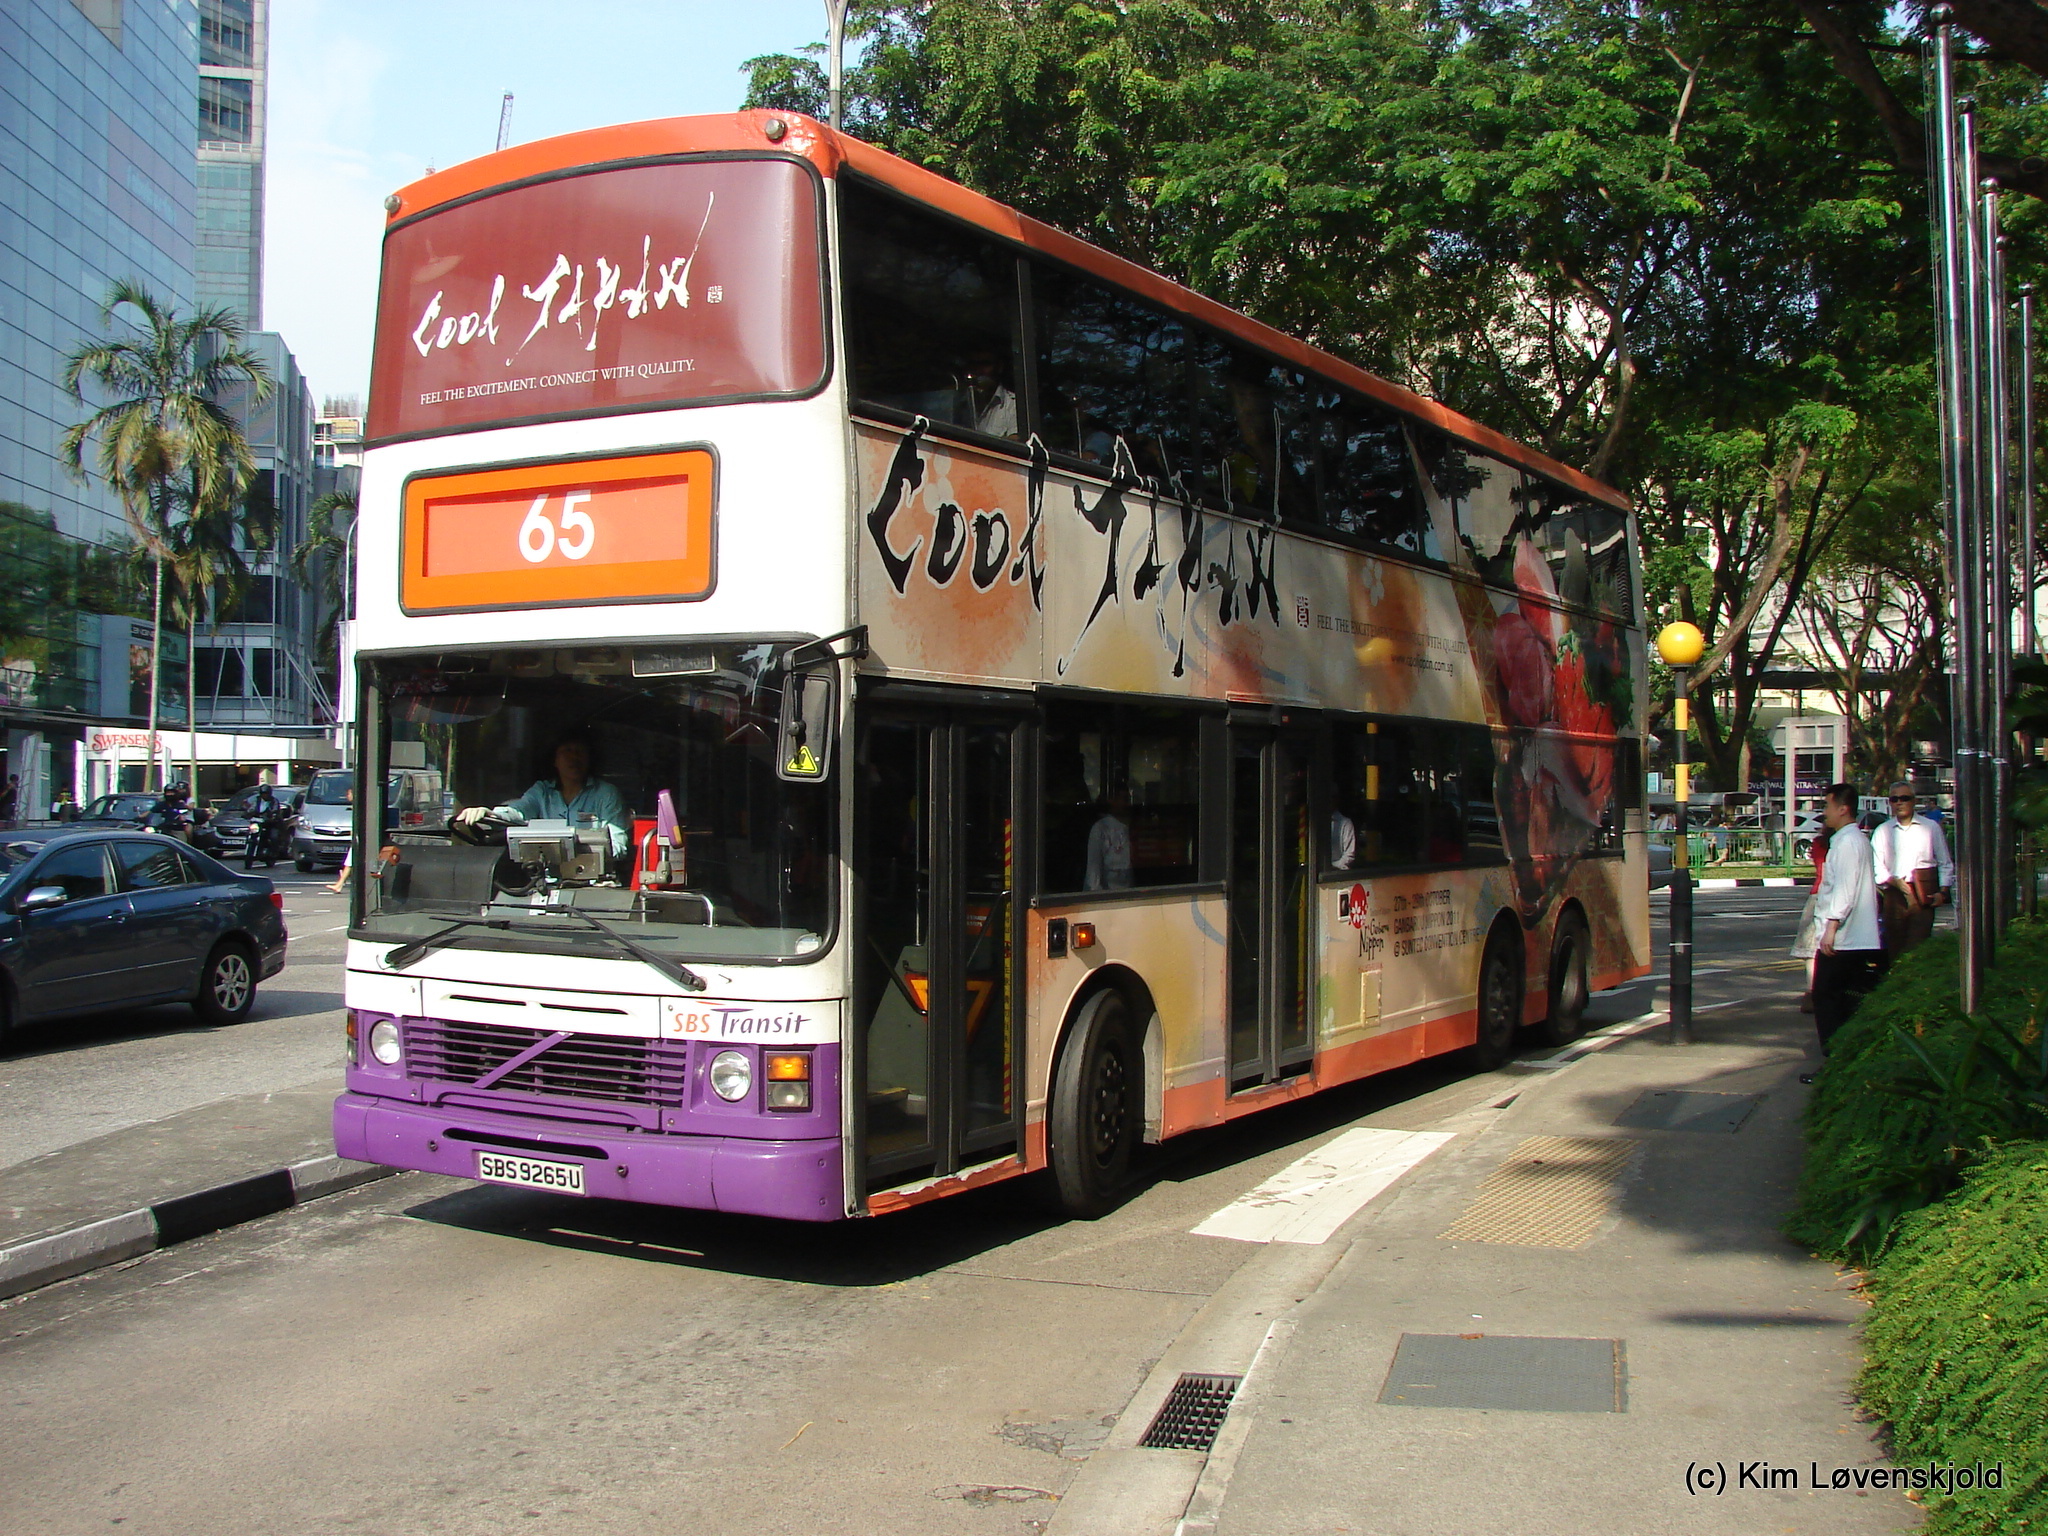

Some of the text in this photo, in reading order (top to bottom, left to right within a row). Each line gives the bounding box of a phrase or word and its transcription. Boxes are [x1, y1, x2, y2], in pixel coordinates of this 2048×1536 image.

[412, 191, 715, 366] Cool JAPAN
[420, 358, 696, 406] FEEL THE EXCITEMENT. CONNECT WITH QUALITY.
[518, 489, 596, 564] 65
[867, 408, 1283, 680] Cool JAPAN
[1316, 614, 1334, 631] FEEL
[1335, 617, 1350, 634] THE
[92, 733, 162, 754] SWENSENS
[1768, 781, 1785, 789] WAL
[1359, 925, 1384, 960] Nippon
[1394, 941, 1400, 957] @
[674, 1008, 812, 1037] SBS Transit
[481, 1156, 582, 1190] SBS9265U
